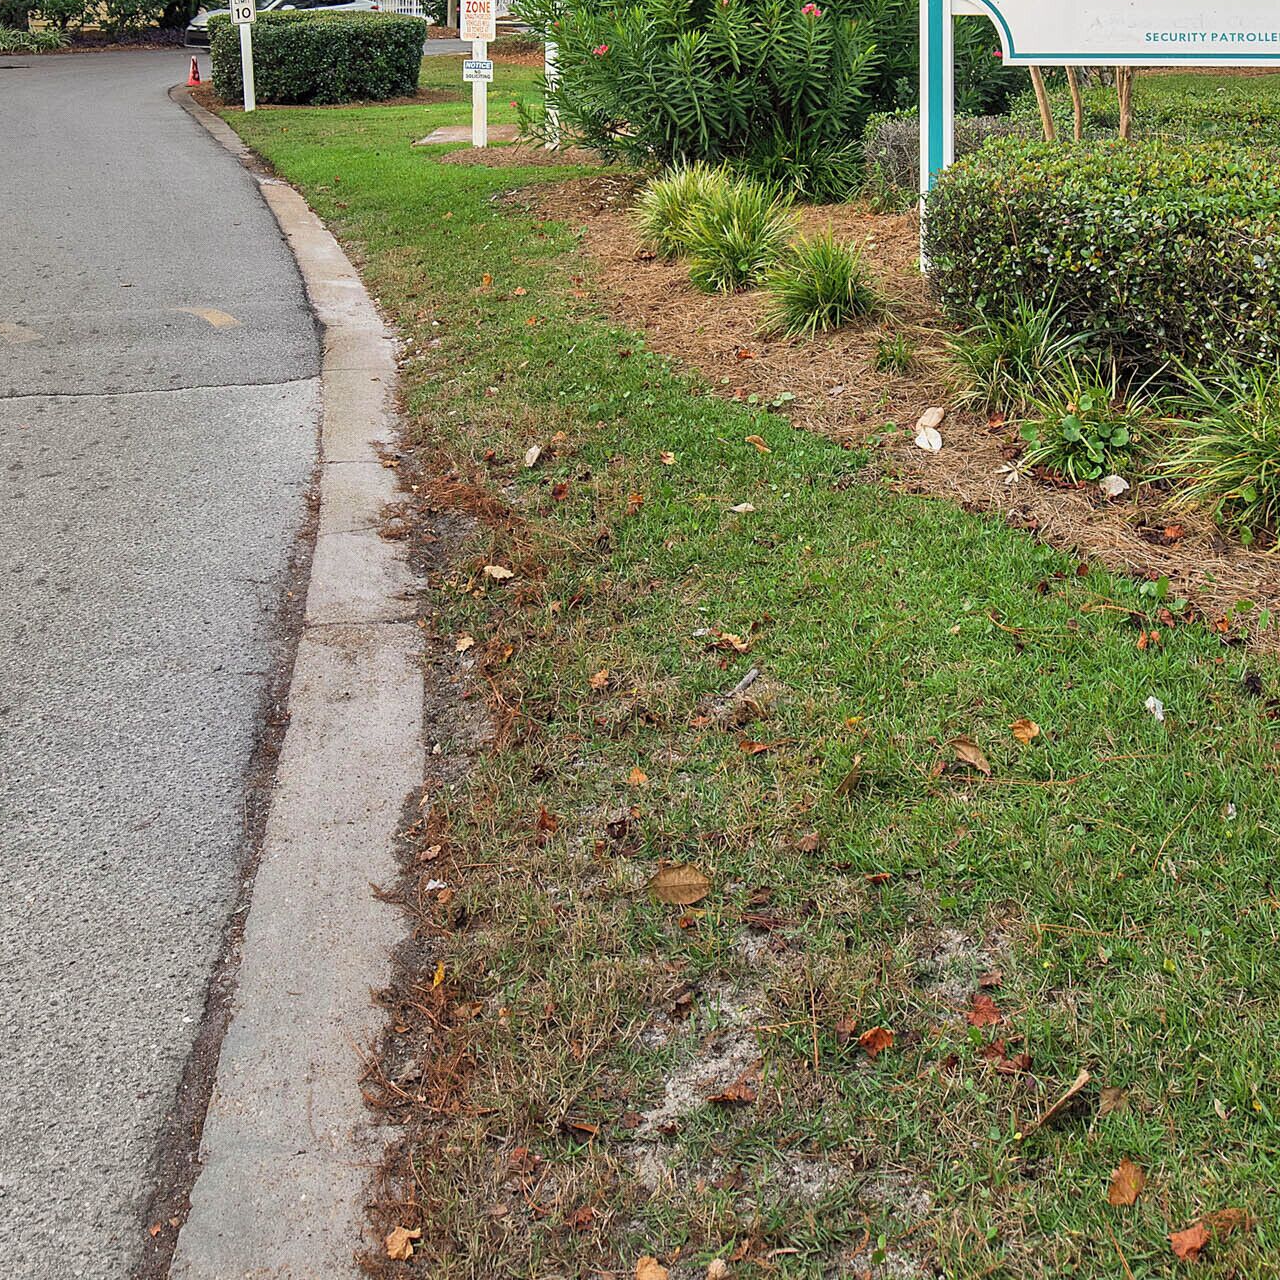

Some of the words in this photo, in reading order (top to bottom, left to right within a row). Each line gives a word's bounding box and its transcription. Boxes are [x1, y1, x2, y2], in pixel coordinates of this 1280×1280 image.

[235, 7, 251, 19] 10
[466, 1, 491, 13] ZONE
[1145, 32, 1207, 42] SECURITY
